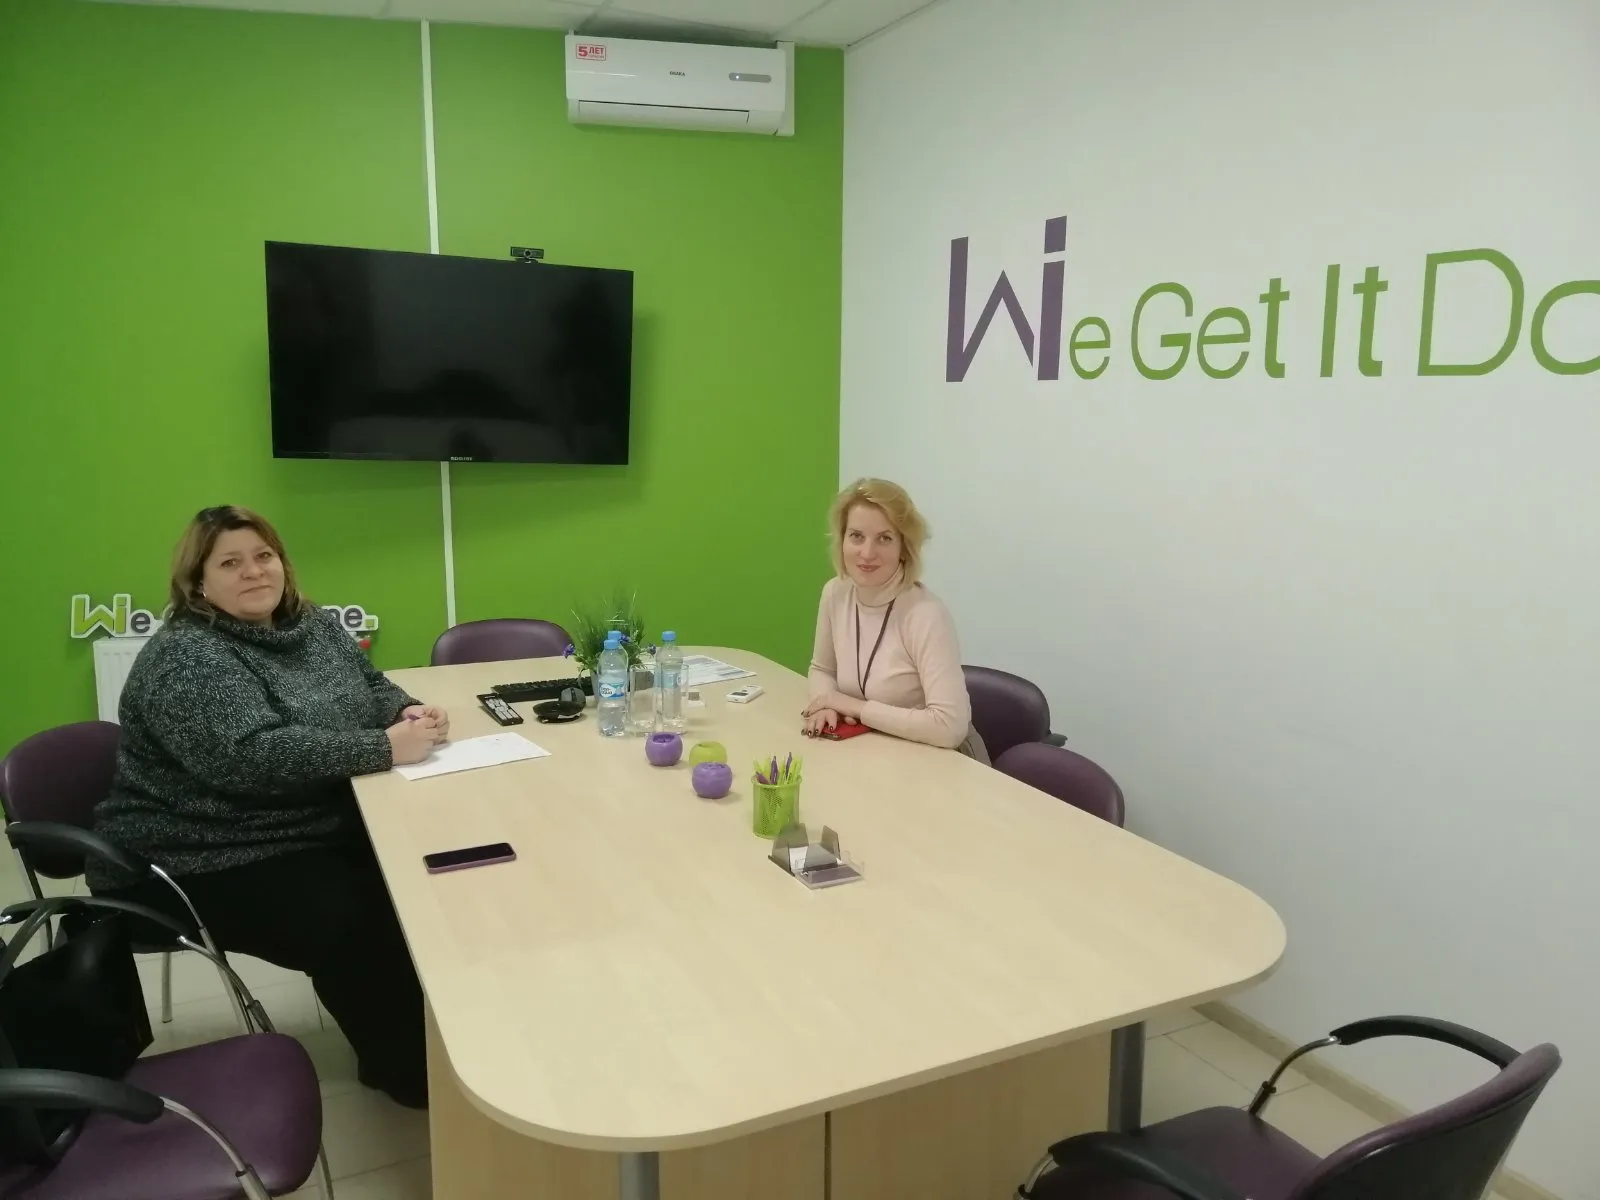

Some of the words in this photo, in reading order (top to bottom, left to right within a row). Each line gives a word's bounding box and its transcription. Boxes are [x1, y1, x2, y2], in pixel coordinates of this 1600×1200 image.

[578, 46, 588, 57] 5
[589, 46, 605, 55] ЛЕТ
[1131, 278, 1291, 381] Get
[1320, 264, 1389, 378] It
